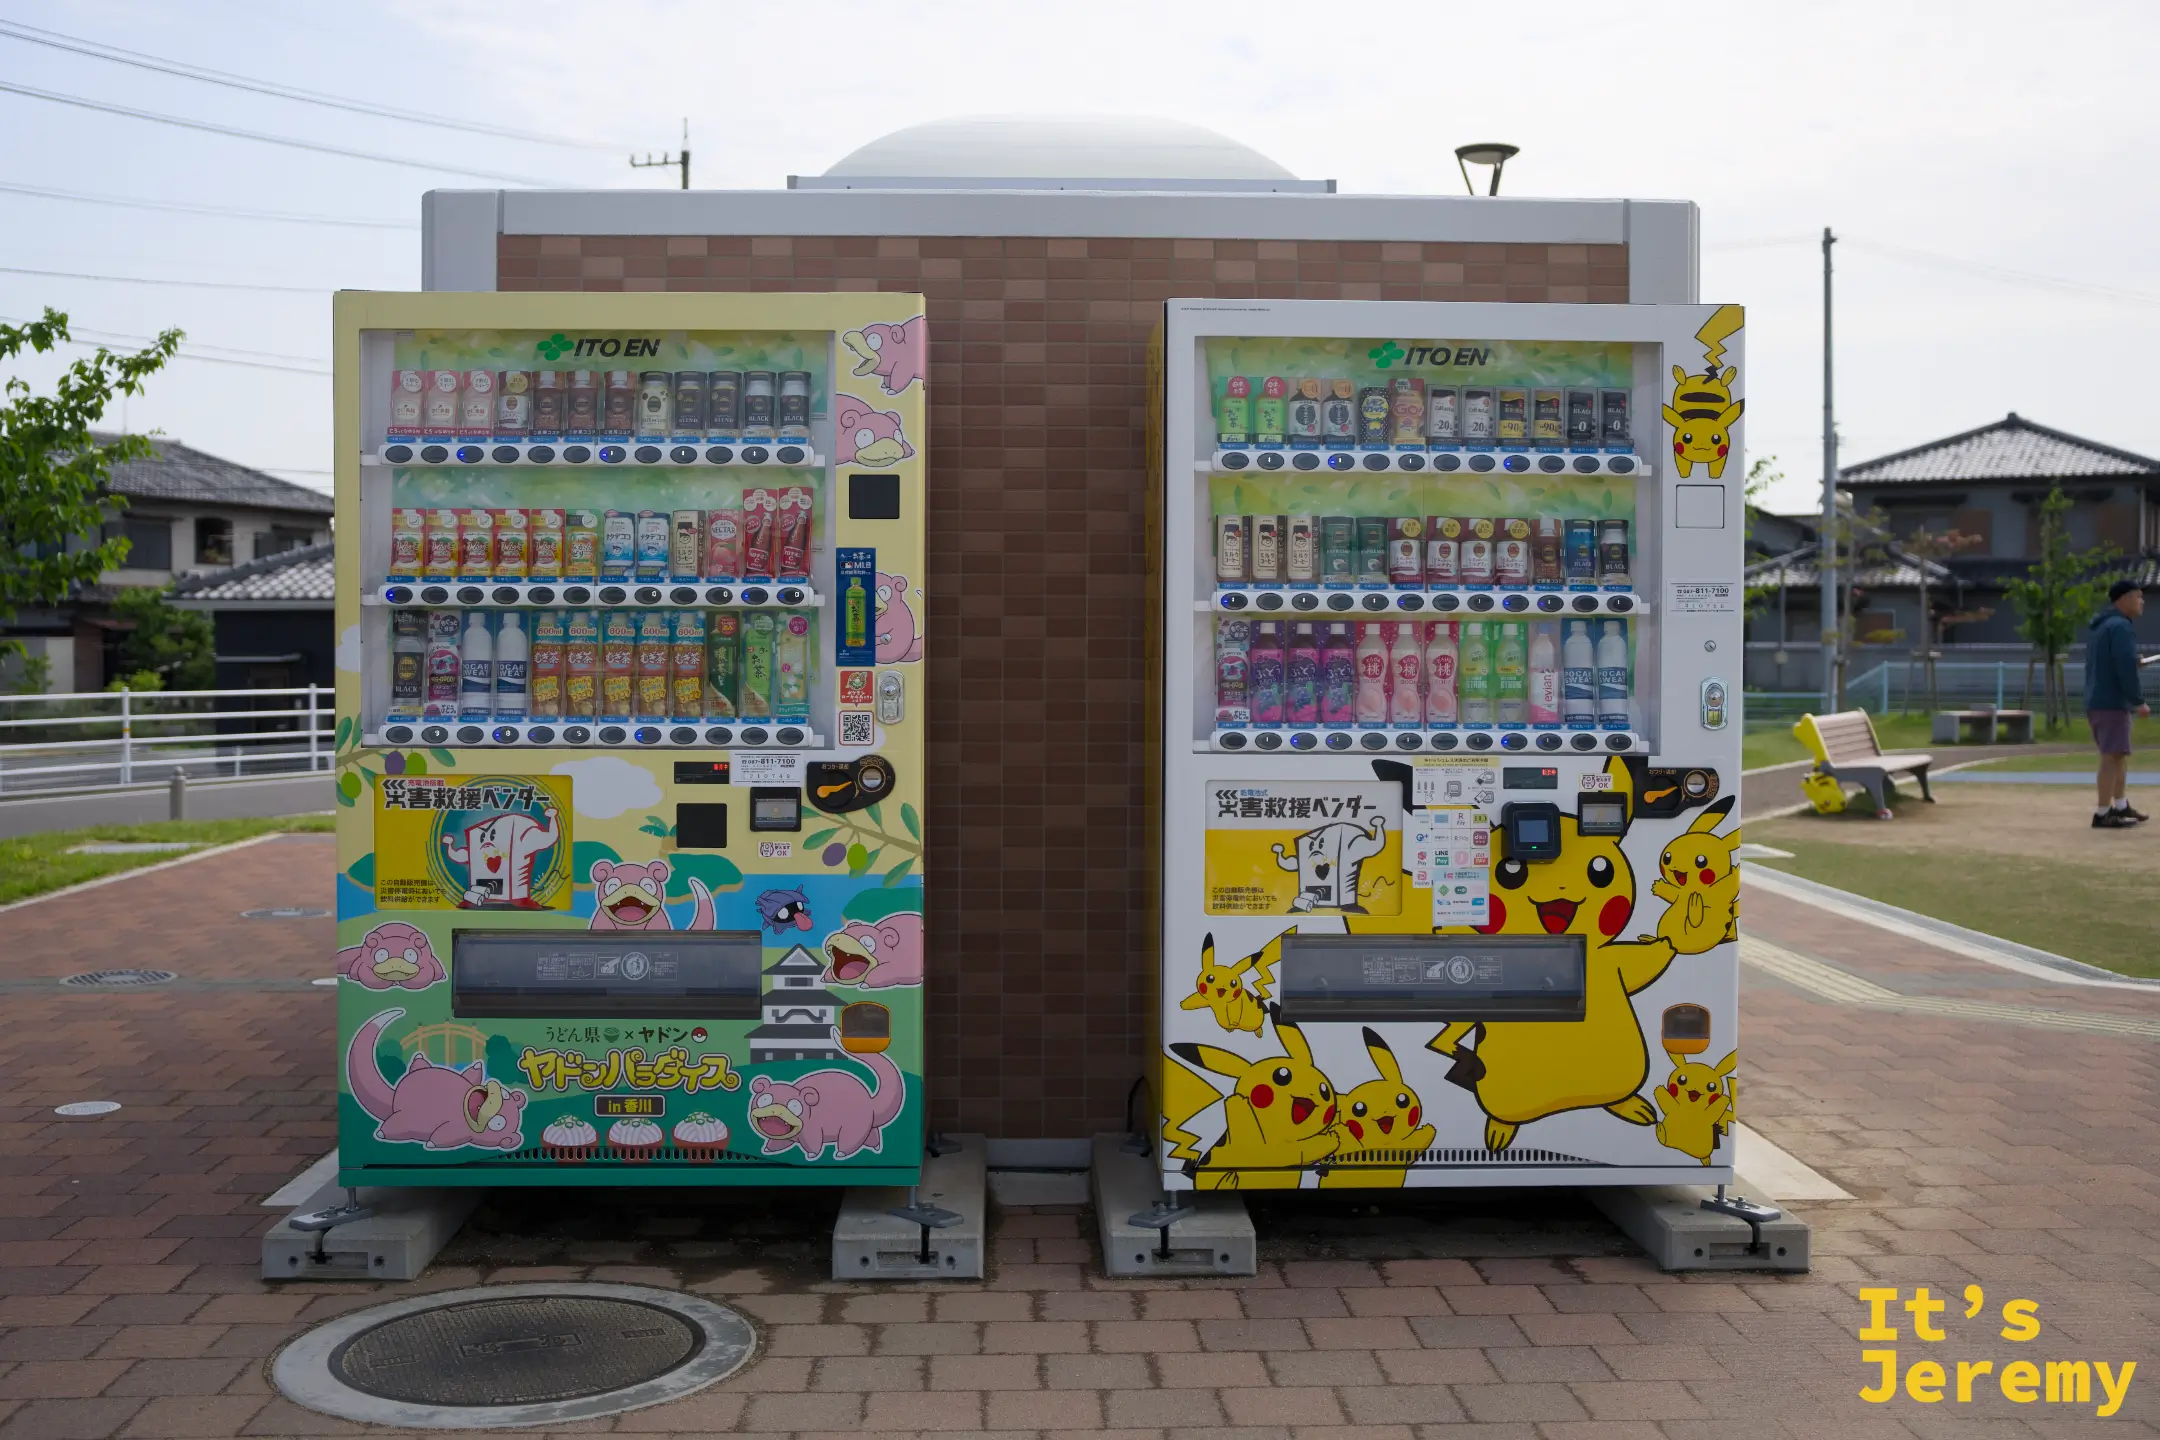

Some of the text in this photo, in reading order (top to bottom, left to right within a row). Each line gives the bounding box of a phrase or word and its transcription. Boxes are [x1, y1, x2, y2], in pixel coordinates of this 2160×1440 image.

[574, 339, 661, 357] ITO EN
[1404, 347, 1490, 366] ITO EN
[1438, 420, 1450, 430] 20
[1472, 421, 1484, 432] 20
[1507, 422, 1519, 432] 90
[1544, 422, 1555, 432] 90
[1578, 420, 1586, 432] 0
[1613, 420, 1620, 430] 0
[712, 527, 735, 535] NECTAR
[854, 561, 872, 569] MLB
[534, 651, 560, 664] むぎ茶
[568, 651, 594, 664] むぎ茶
[606, 651, 631, 664] むぎ茶
[640, 651, 666, 664] むぎ茶
[674, 651, 700, 664] むぎ茶
[1367, 663, 1380, 676] 桃
[1404, 664, 1416, 677] 桃
[1438, 664, 1452, 676] 桃
[1216, 790, 1376, 818] 災害救援ベンダー
[555, 1026, 601, 1043] うどん県
[638, 1027, 688, 1043] ヤドン
[518, 1047, 743, 1093] ヤドンパラダイス
[609, 1099, 652, 1113] in 香川
